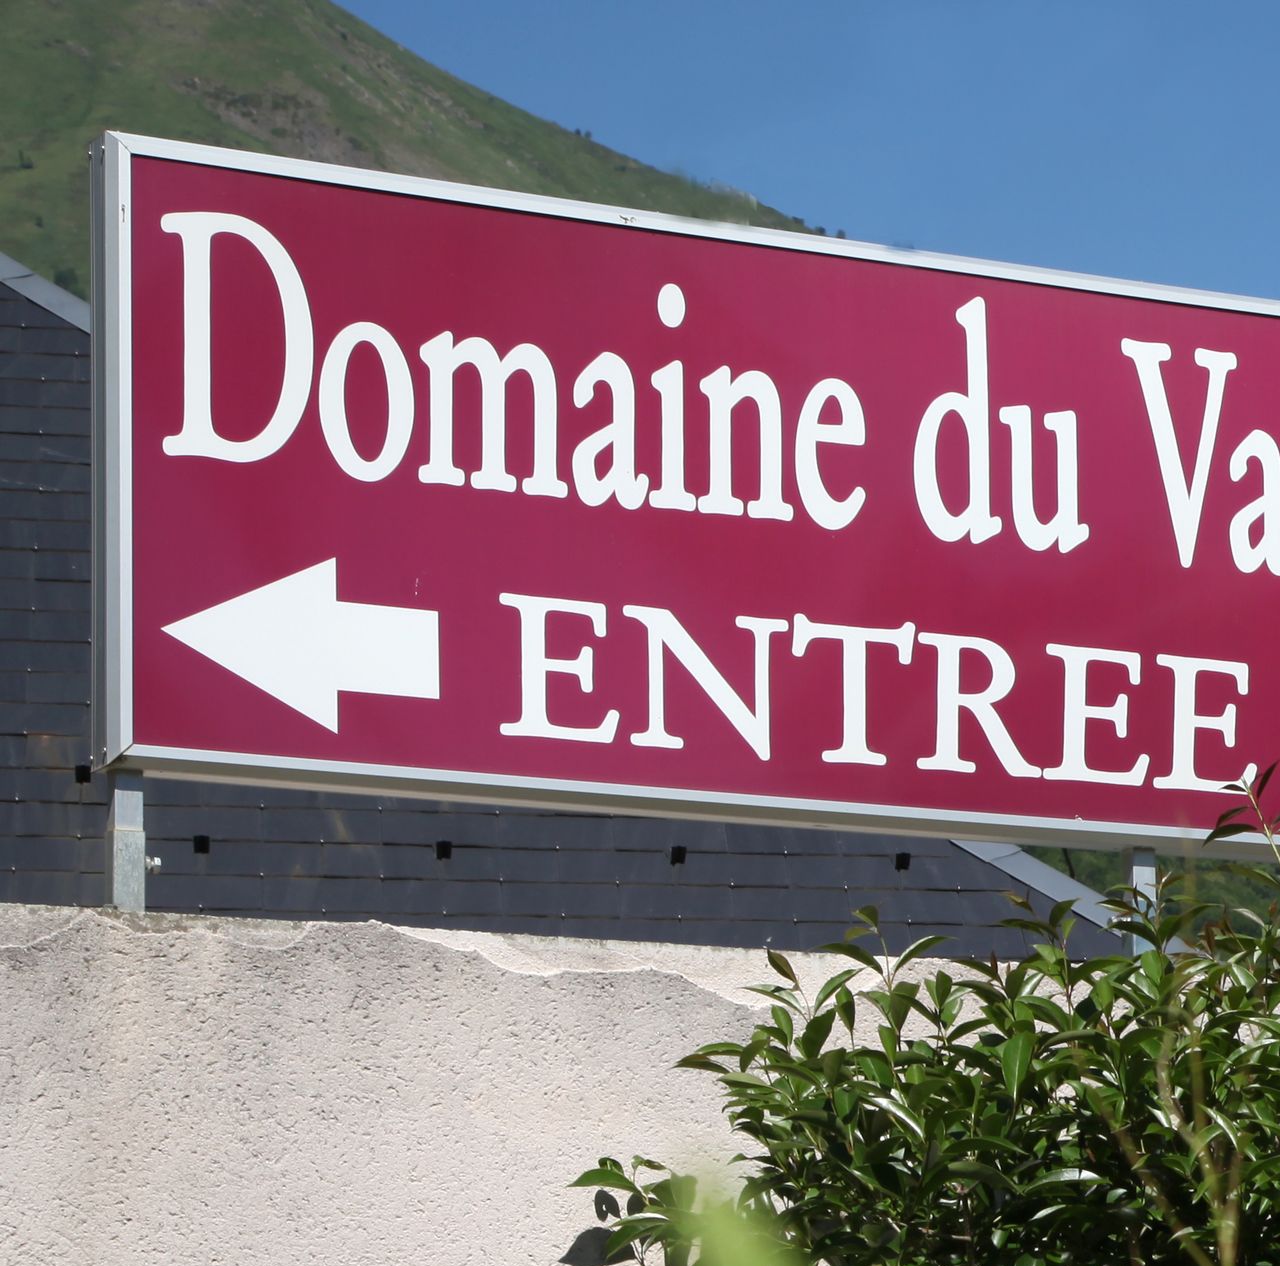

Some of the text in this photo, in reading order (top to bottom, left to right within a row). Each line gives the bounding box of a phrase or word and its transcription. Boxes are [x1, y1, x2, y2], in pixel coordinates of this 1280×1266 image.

[160, 211, 867, 531] Domaine
[913, 295, 1090, 554] du
[498, 592, 1258, 796] ENTREE
